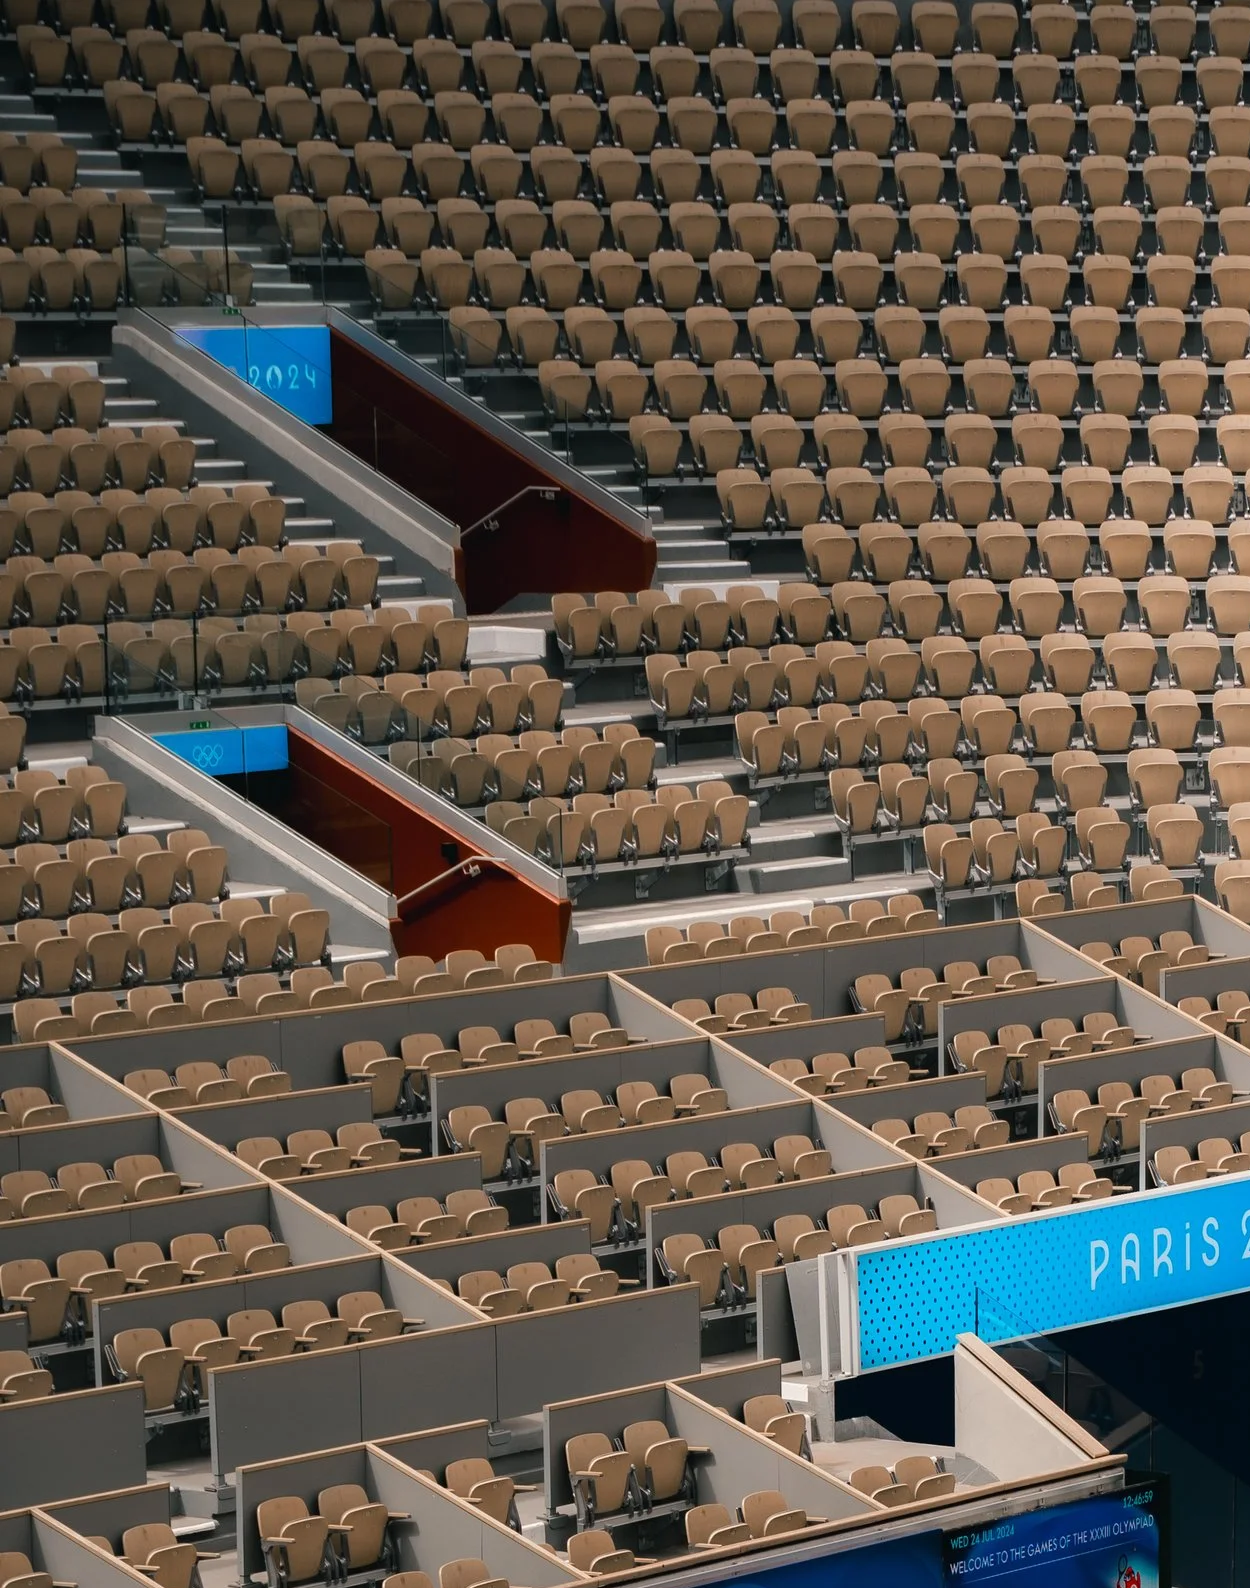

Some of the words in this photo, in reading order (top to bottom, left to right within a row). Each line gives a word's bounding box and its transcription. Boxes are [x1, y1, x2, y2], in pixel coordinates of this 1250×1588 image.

[949, 1553, 995, 1575] WELCOME
[996, 1550, 1009, 1565] TO
[1010, 1546, 1026, 1561] THE
[1027, 1538, 1058, 1557] GAMES
[1060, 1535, 1071, 1549] OF
[1073, 1530, 1088, 1546] THE
[1089, 1525, 1111, 1542] XXXIII
[1112, 1514, 1154, 1535] OLYMPIAD
[950, 1535, 969, 1550] WED
[970, 1533, 981, 1546] 24
[981, 1529, 995, 1543] JUL
[996, 1524, 1015, 1540] 2024
